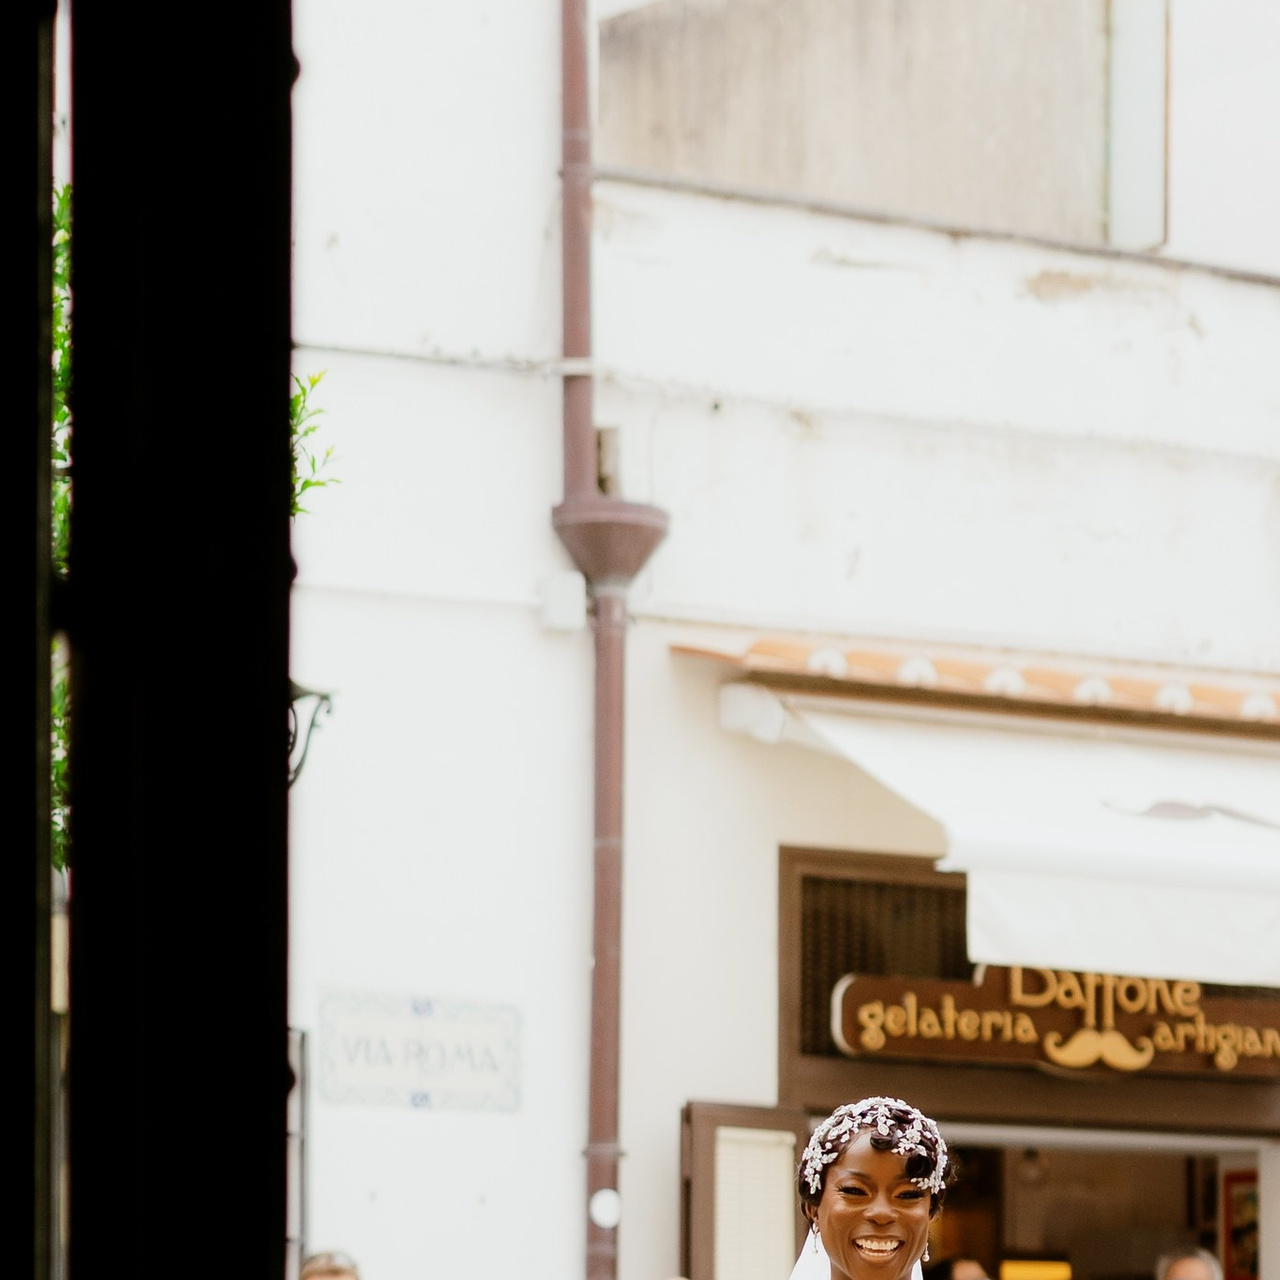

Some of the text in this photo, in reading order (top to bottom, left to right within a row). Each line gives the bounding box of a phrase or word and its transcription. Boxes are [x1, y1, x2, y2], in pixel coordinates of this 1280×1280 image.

[857, 991, 1039, 1052] gelateria
[340, 1036, 502, 1073] VIA ROMA
